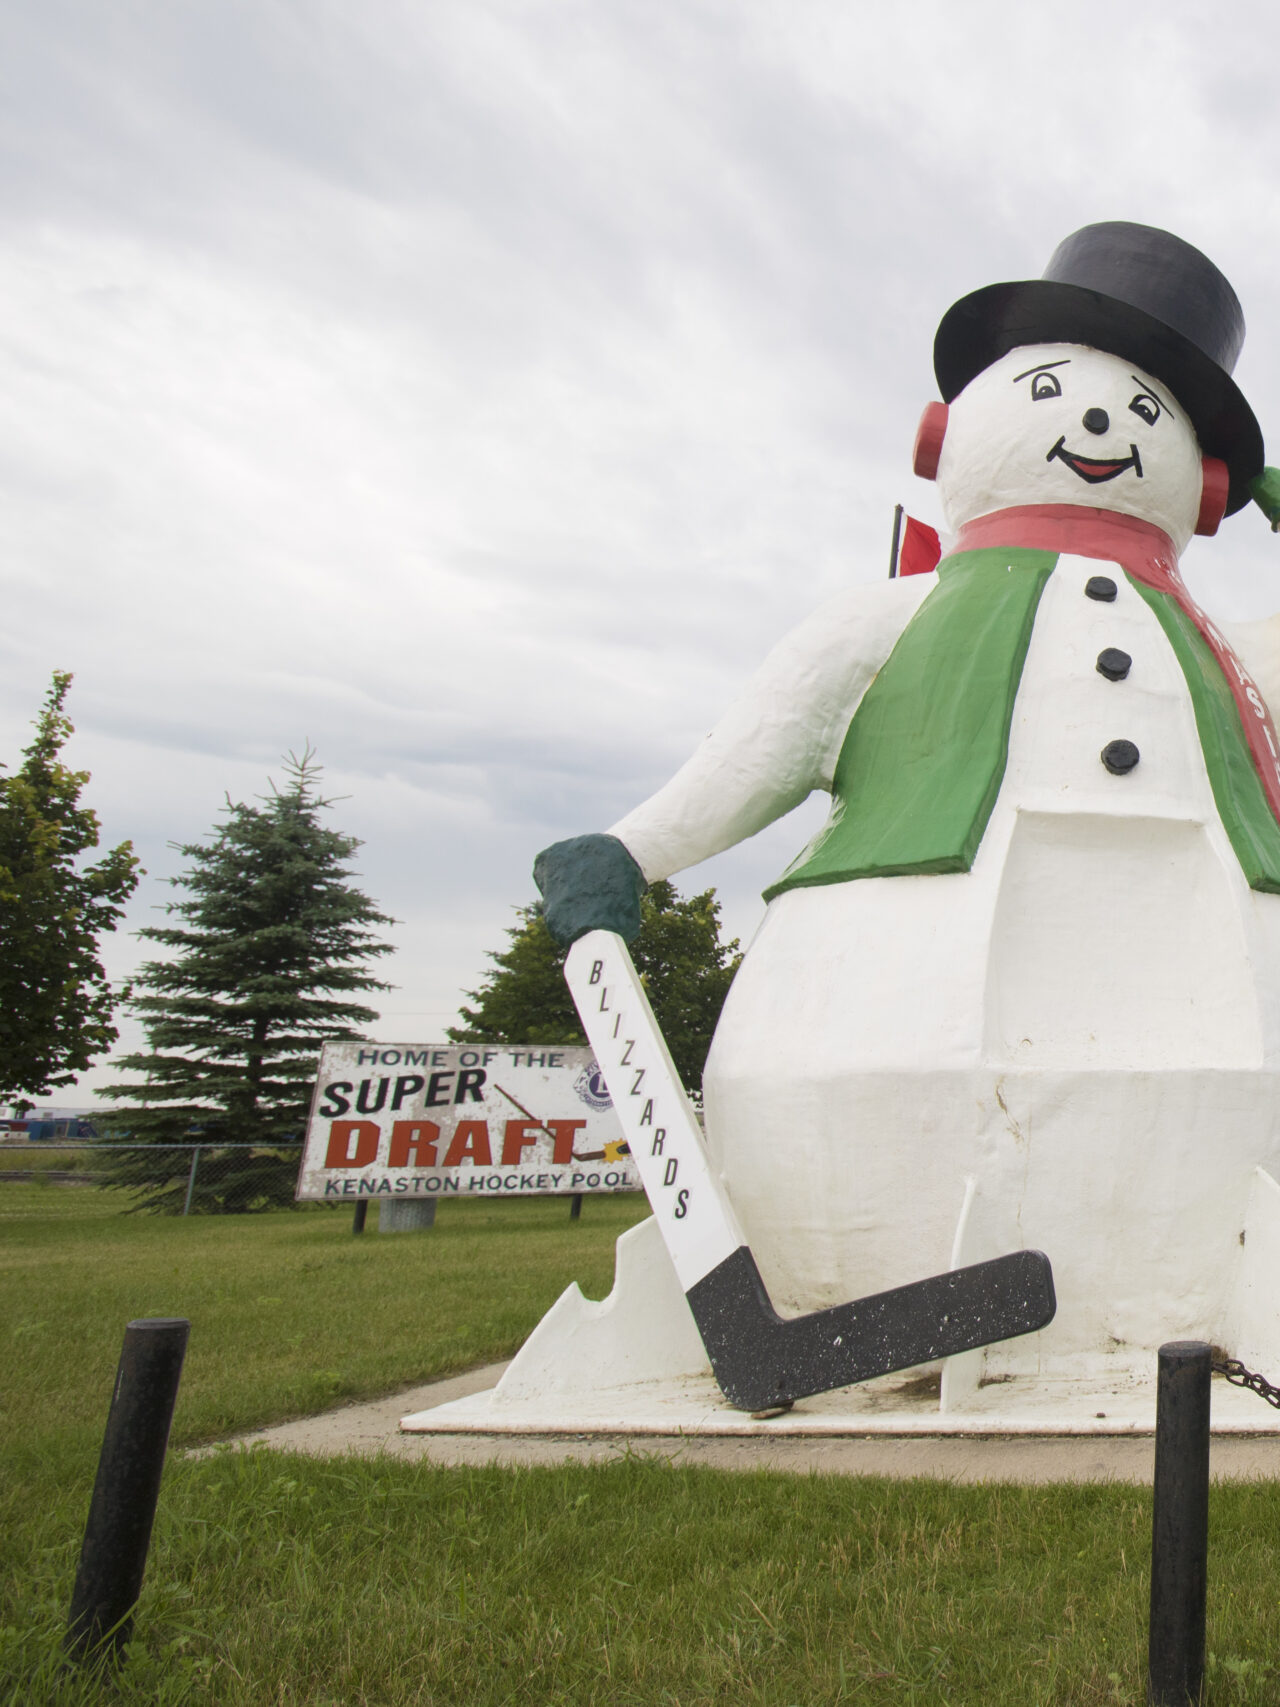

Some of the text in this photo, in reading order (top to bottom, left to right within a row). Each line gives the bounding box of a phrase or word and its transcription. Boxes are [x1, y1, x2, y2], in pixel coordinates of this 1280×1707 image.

[357, 1049, 565, 1068] HOME OF THE
[319, 1068, 486, 1118] SUPER
[589, 960, 689, 1220] BLIZZARDS
[324, 1119, 587, 1169] DRAFT
[324, 1172, 633, 1195] KENASTON HOCKEY POOL
